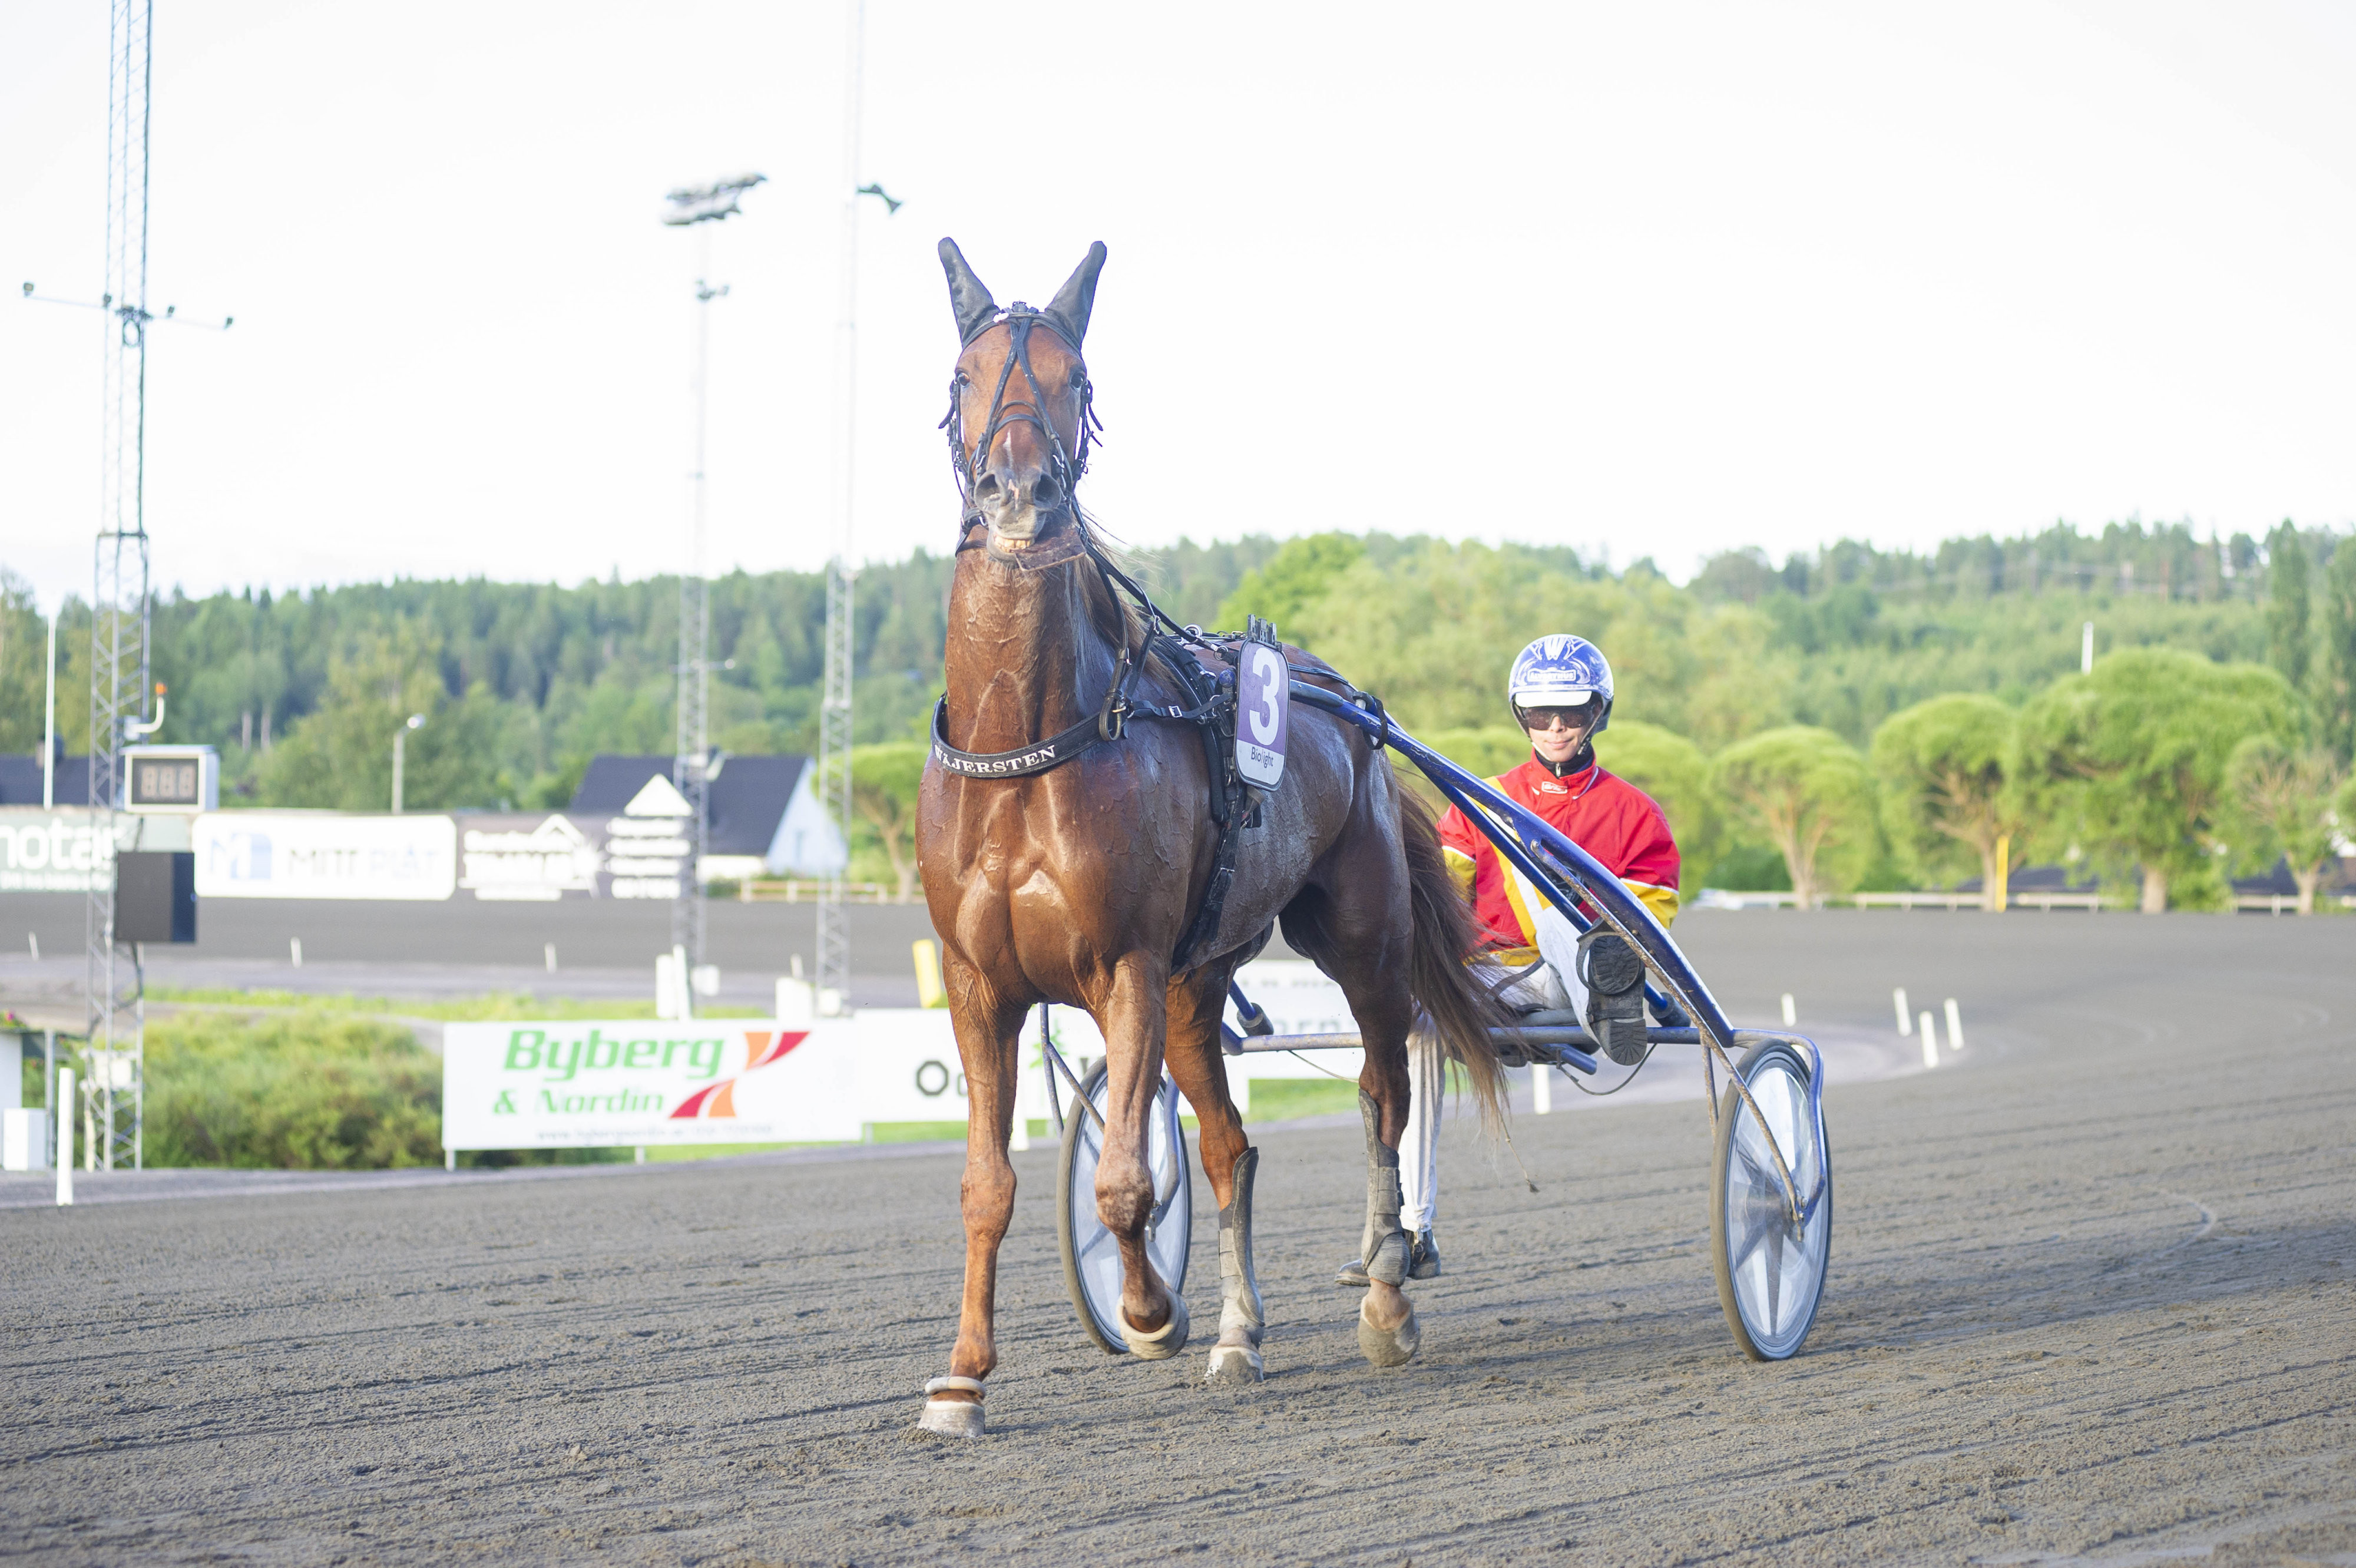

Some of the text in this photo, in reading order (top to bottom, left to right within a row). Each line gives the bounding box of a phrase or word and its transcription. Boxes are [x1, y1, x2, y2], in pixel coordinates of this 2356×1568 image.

[1249, 647, 1279, 746] 3
[934, 744, 1056, 773] WÄJERSTEN
[1251, 746, 1273, 768] Biolight
[288, 848, 359, 876] MITT
[504, 1030, 725, 1081] Byberg
[492, 1089, 664, 1115] & Nordin
